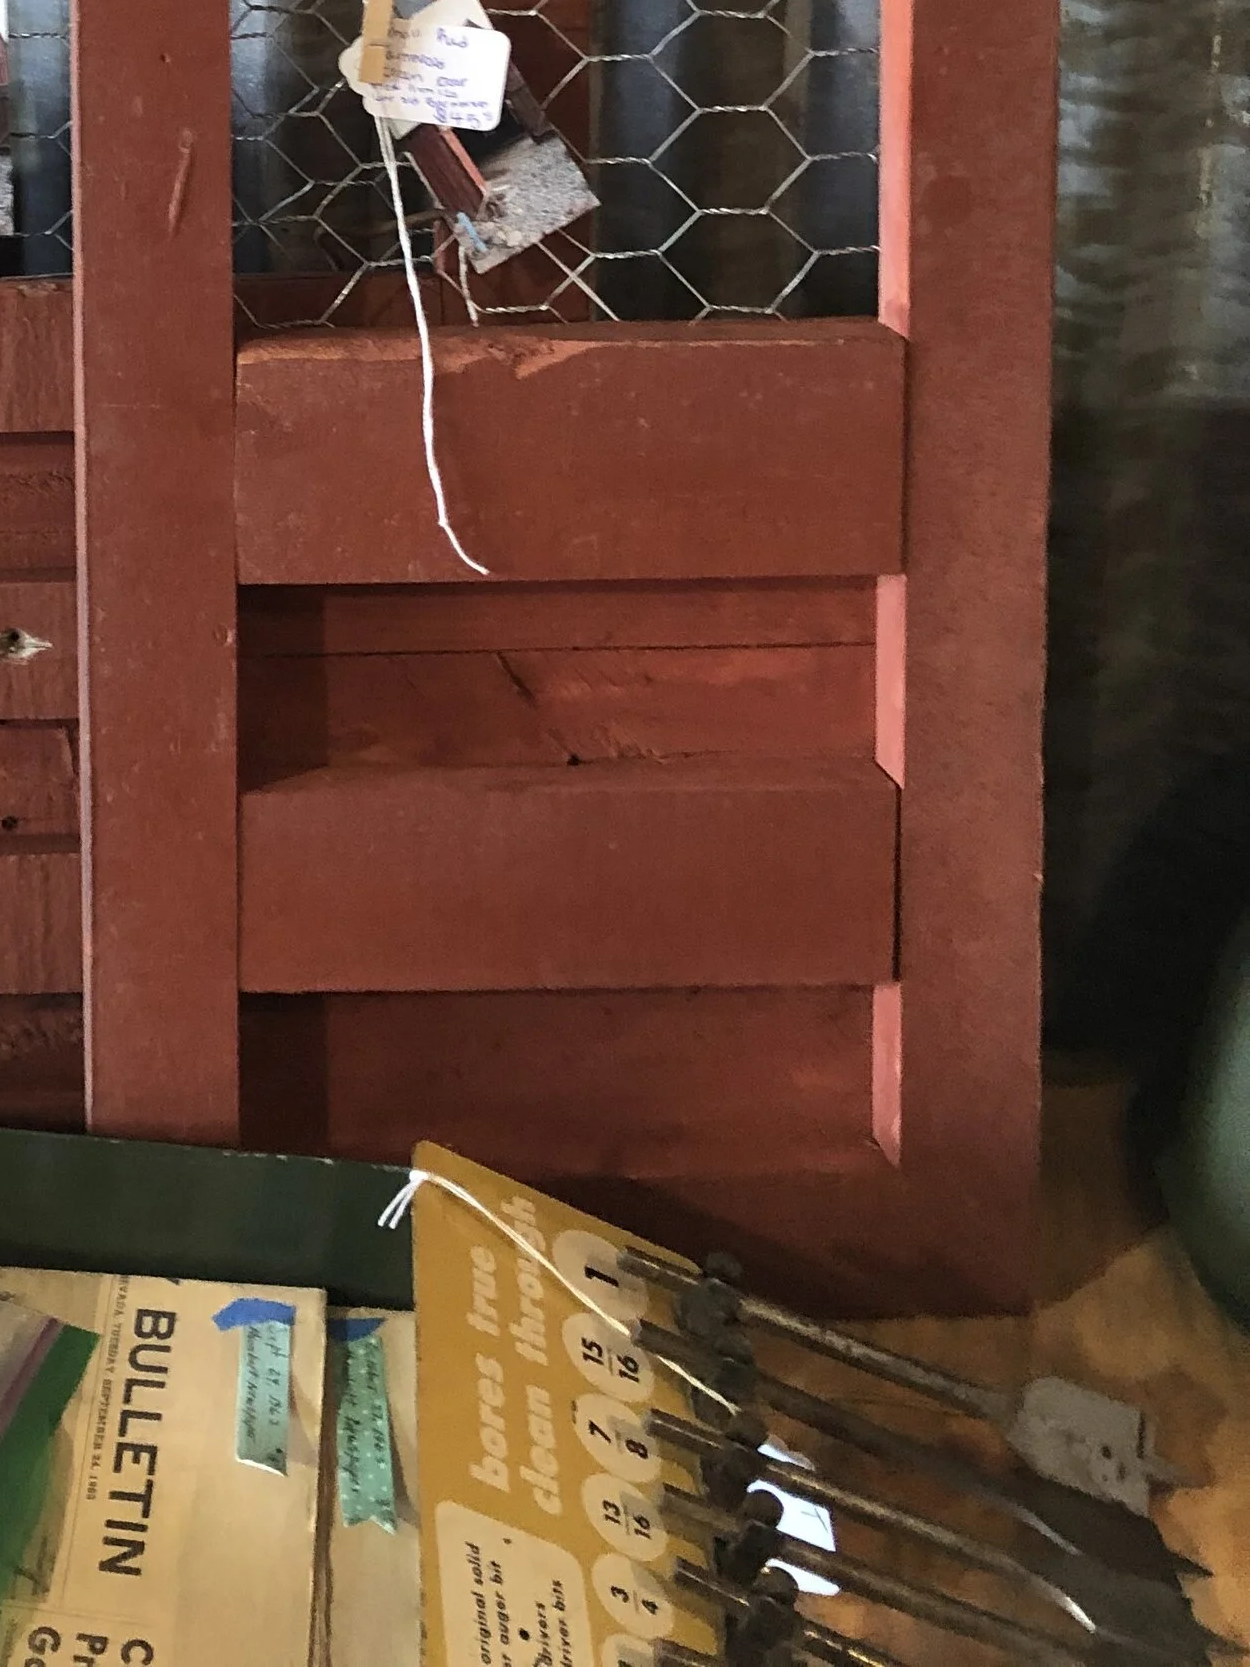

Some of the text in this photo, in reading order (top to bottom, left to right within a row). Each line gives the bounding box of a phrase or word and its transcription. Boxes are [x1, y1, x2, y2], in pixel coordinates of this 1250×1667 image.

[584, 1265, 620, 1288] 1
[500, 1195, 563, 1516] clean through
[580, 1336, 604, 1366] 15
[466, 1244, 511, 1494] bores true
[616, 1355, 640, 1384] 16
[98, 1308, 177, 1577] BULLETIN
[588, 1419, 612, 1444] 7
[624, 1438, 650, 1460] 8
[602, 1499, 622, 1526] 13
[633, 1513, 653, 1541] 16
[484, 1560, 505, 1586] bit
[464, 1540, 492, 1665] original solid
[551, 1579, 568, 1612] bits
[610, 1585, 630, 1603] 3
[640, 1597, 660, 1617] 4
[491, 1591, 511, 1646] auger
